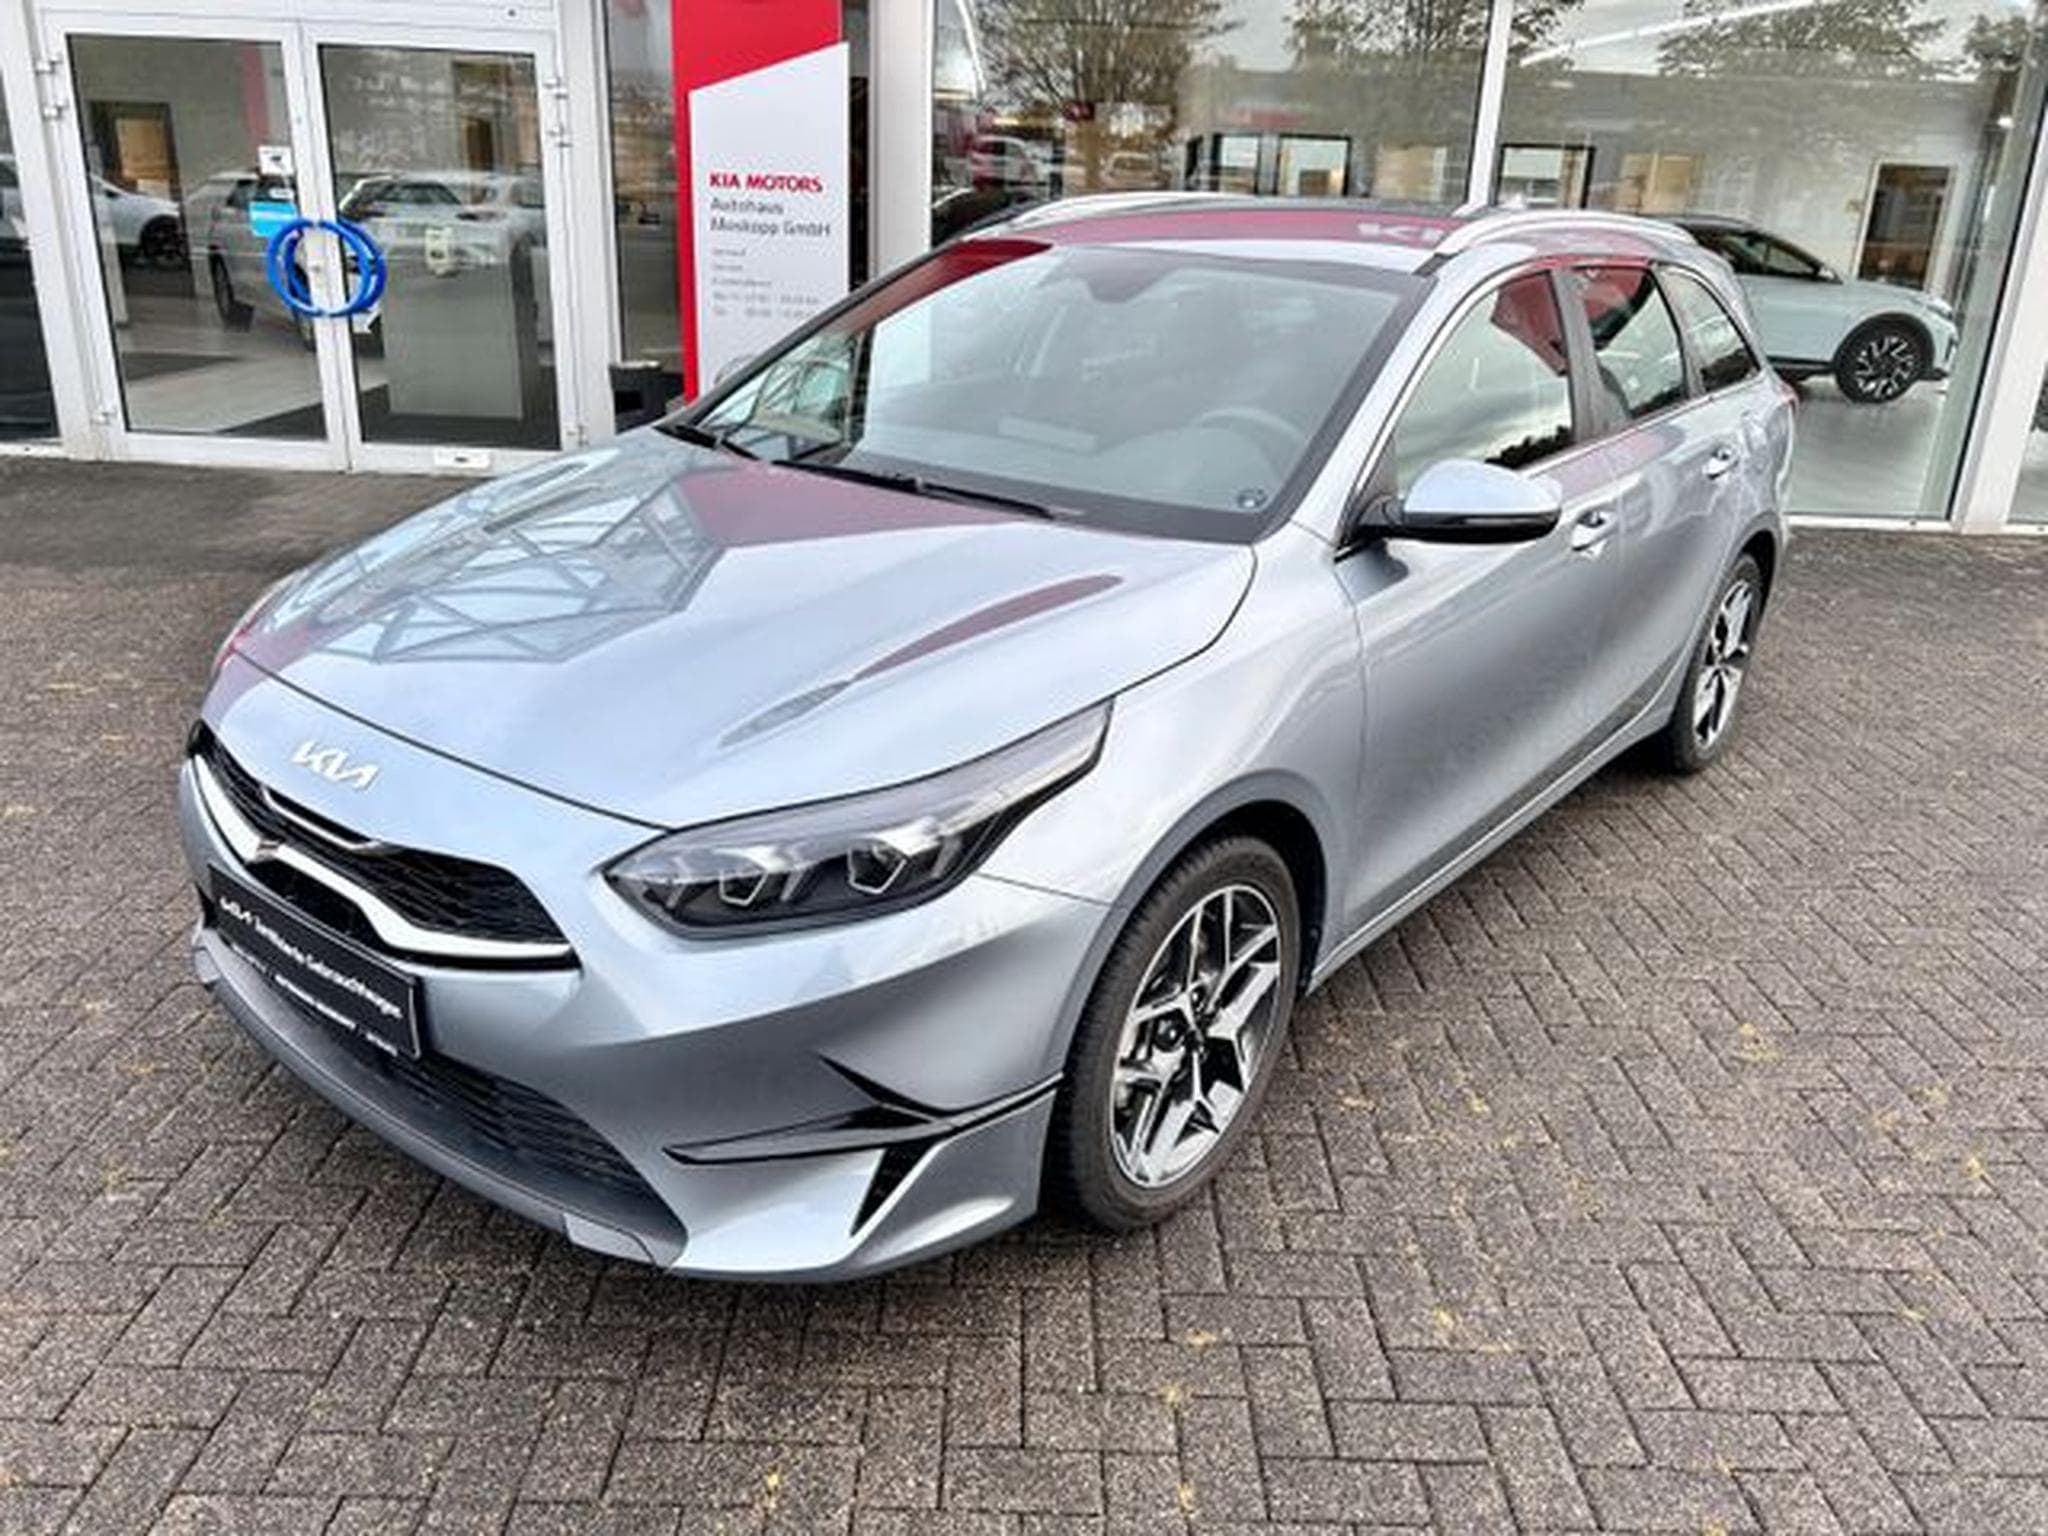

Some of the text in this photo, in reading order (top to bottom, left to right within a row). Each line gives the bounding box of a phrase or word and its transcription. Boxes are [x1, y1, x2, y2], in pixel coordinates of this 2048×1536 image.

[709, 173, 823, 192] KIA MOTORS
[711, 198, 783, 214] Autohaus
[783, 220, 831, 237] GmbH
[289, 739, 379, 791] KIA
